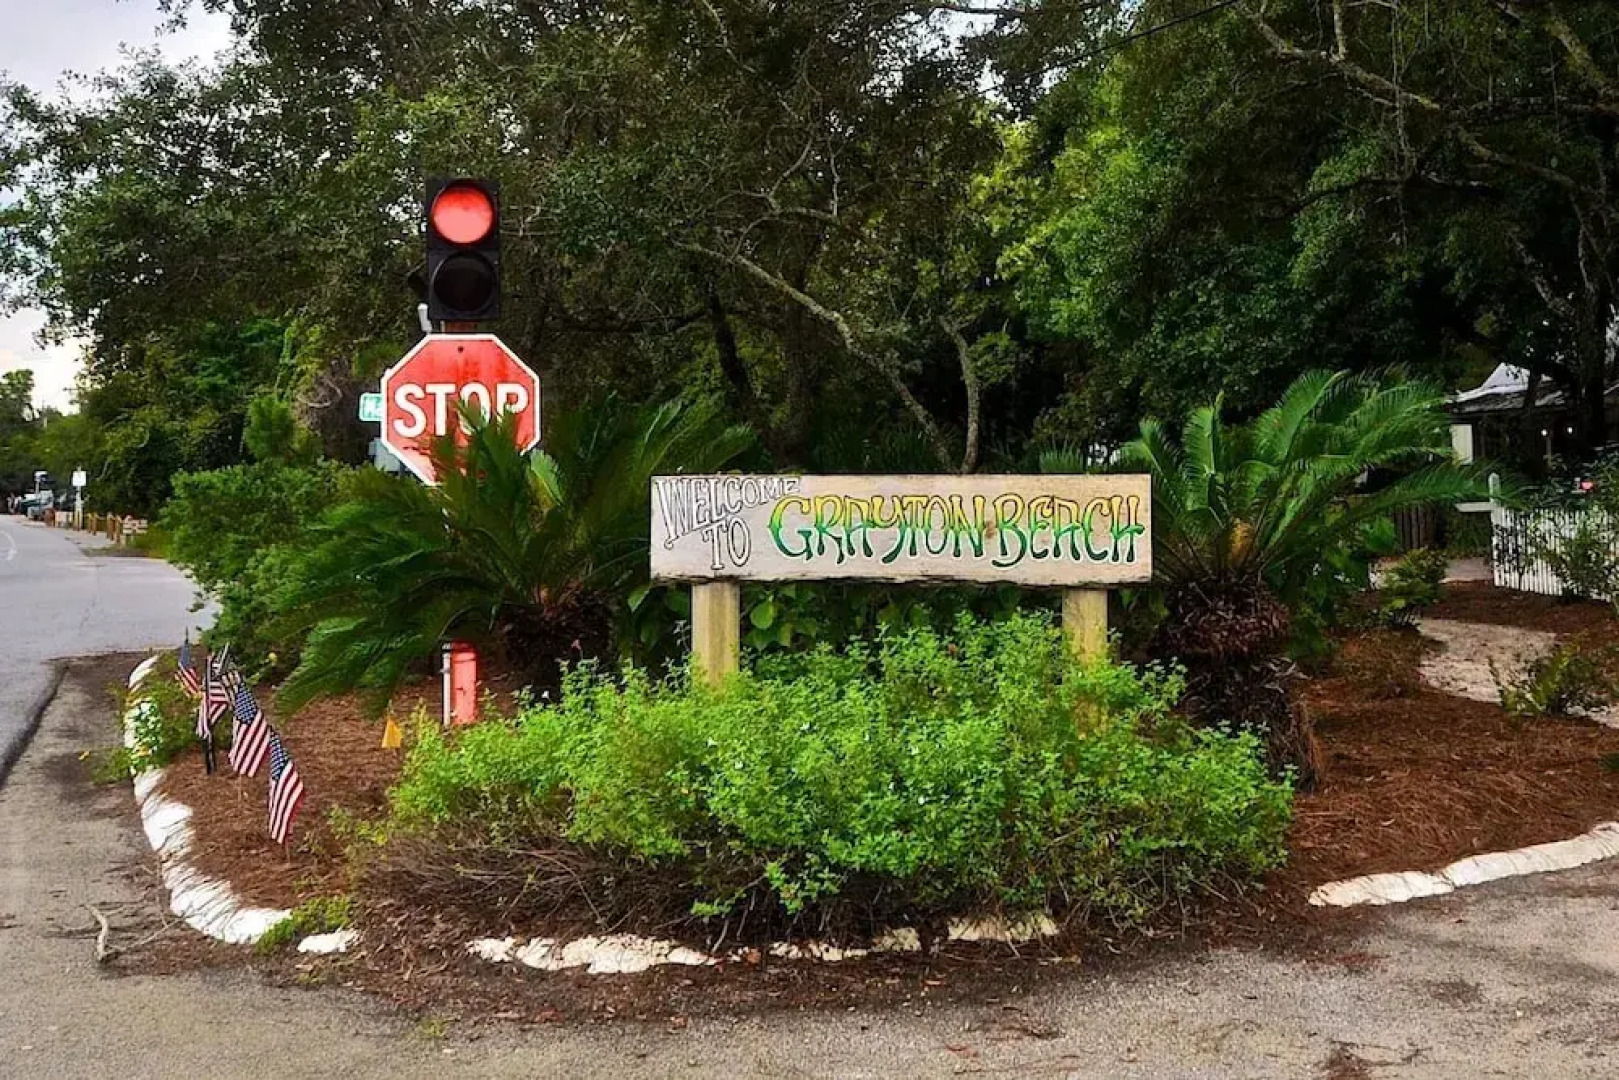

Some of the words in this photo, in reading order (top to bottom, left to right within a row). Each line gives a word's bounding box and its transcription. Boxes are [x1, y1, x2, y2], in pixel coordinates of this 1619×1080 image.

[394, 383, 529, 438] STOP
[656, 477, 801, 549] WELCOME
[702, 515, 752, 570] TO
[769, 494, 985, 564] GRAYTON
[991, 493, 1145, 567] BEACH
